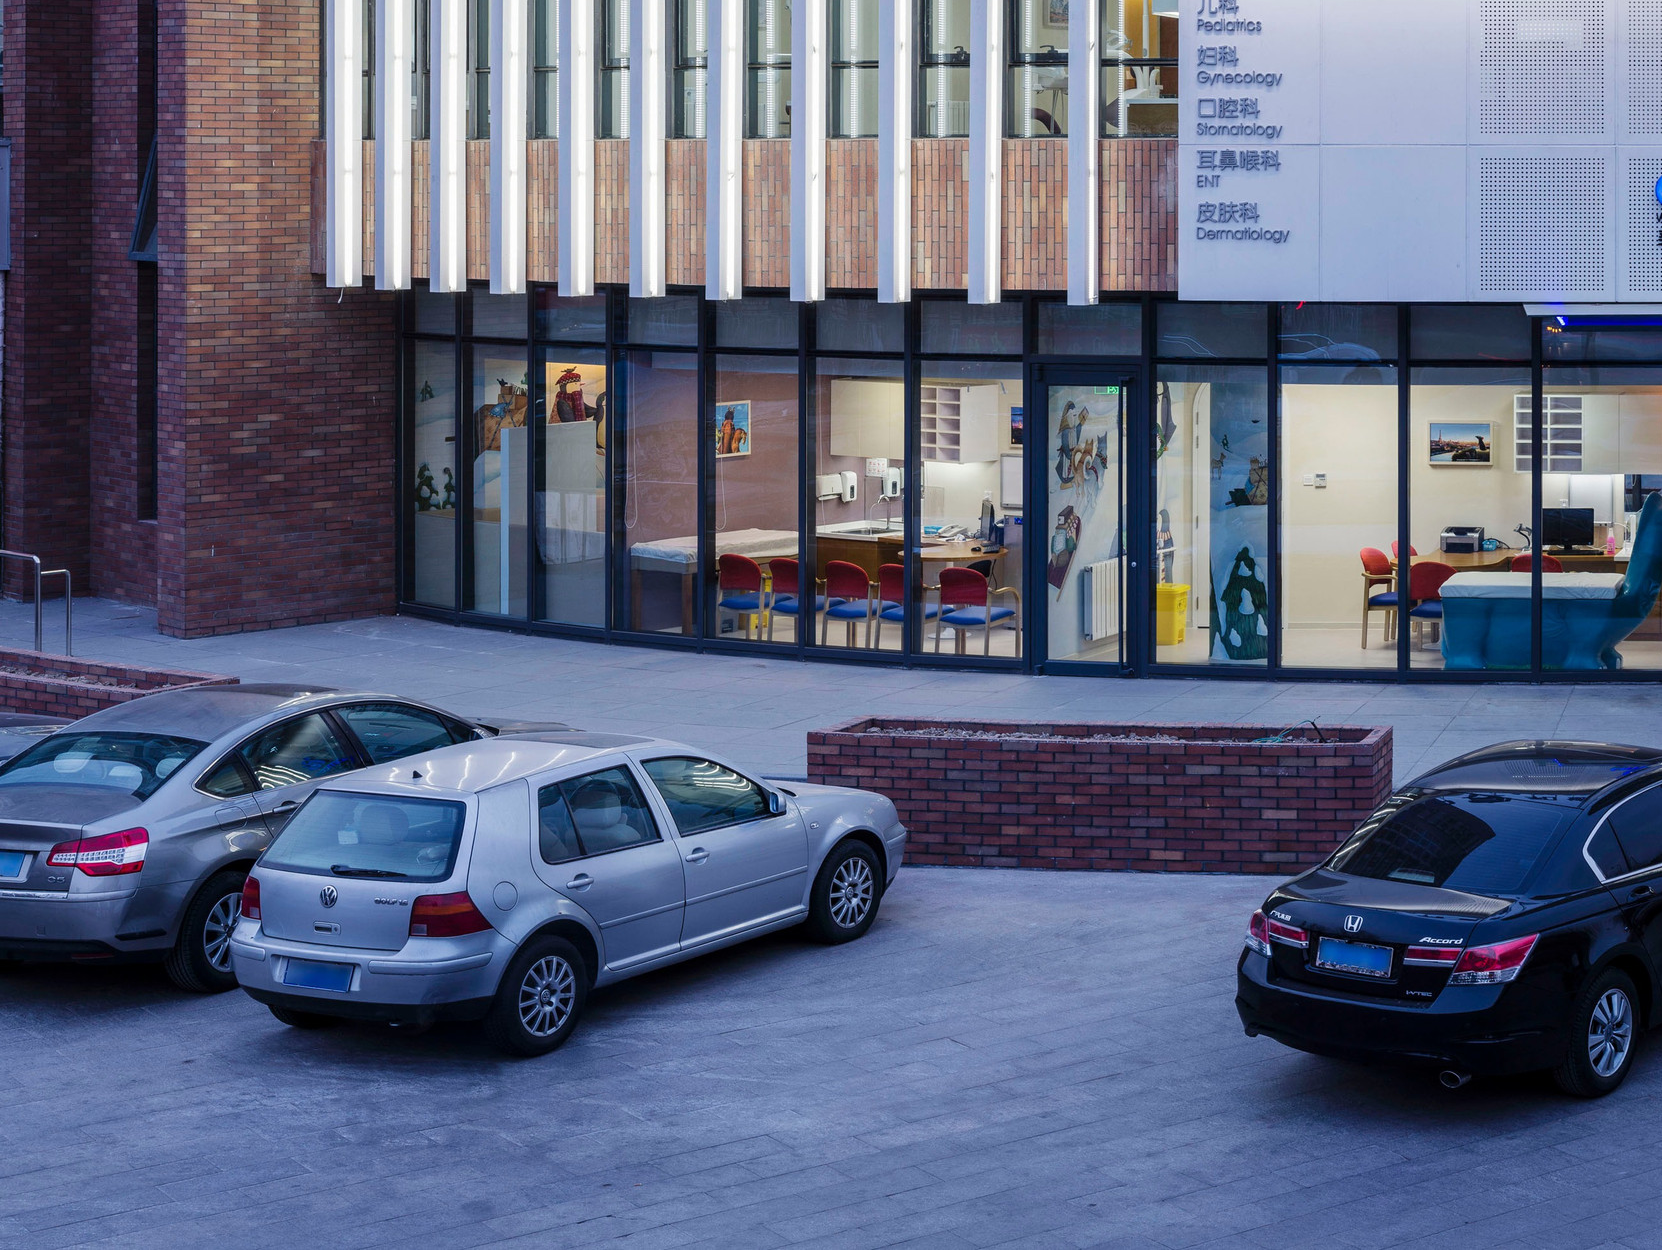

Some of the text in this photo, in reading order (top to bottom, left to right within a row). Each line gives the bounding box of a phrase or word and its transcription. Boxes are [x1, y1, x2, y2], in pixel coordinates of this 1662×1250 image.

[1196, 18, 1263, 33] Pediatrics
[1196, 45, 1240, 67] 妇科
[1196, 70, 1283, 87] Gynecology
[1197, 97, 1261, 119] 口腔科
[1196, 149, 1282, 171] 耳鼻喉科
[1196, 174, 1221, 188] ENT
[1196, 201, 1261, 224] 皮肤科
[1418, 936, 1464, 945] Accord
